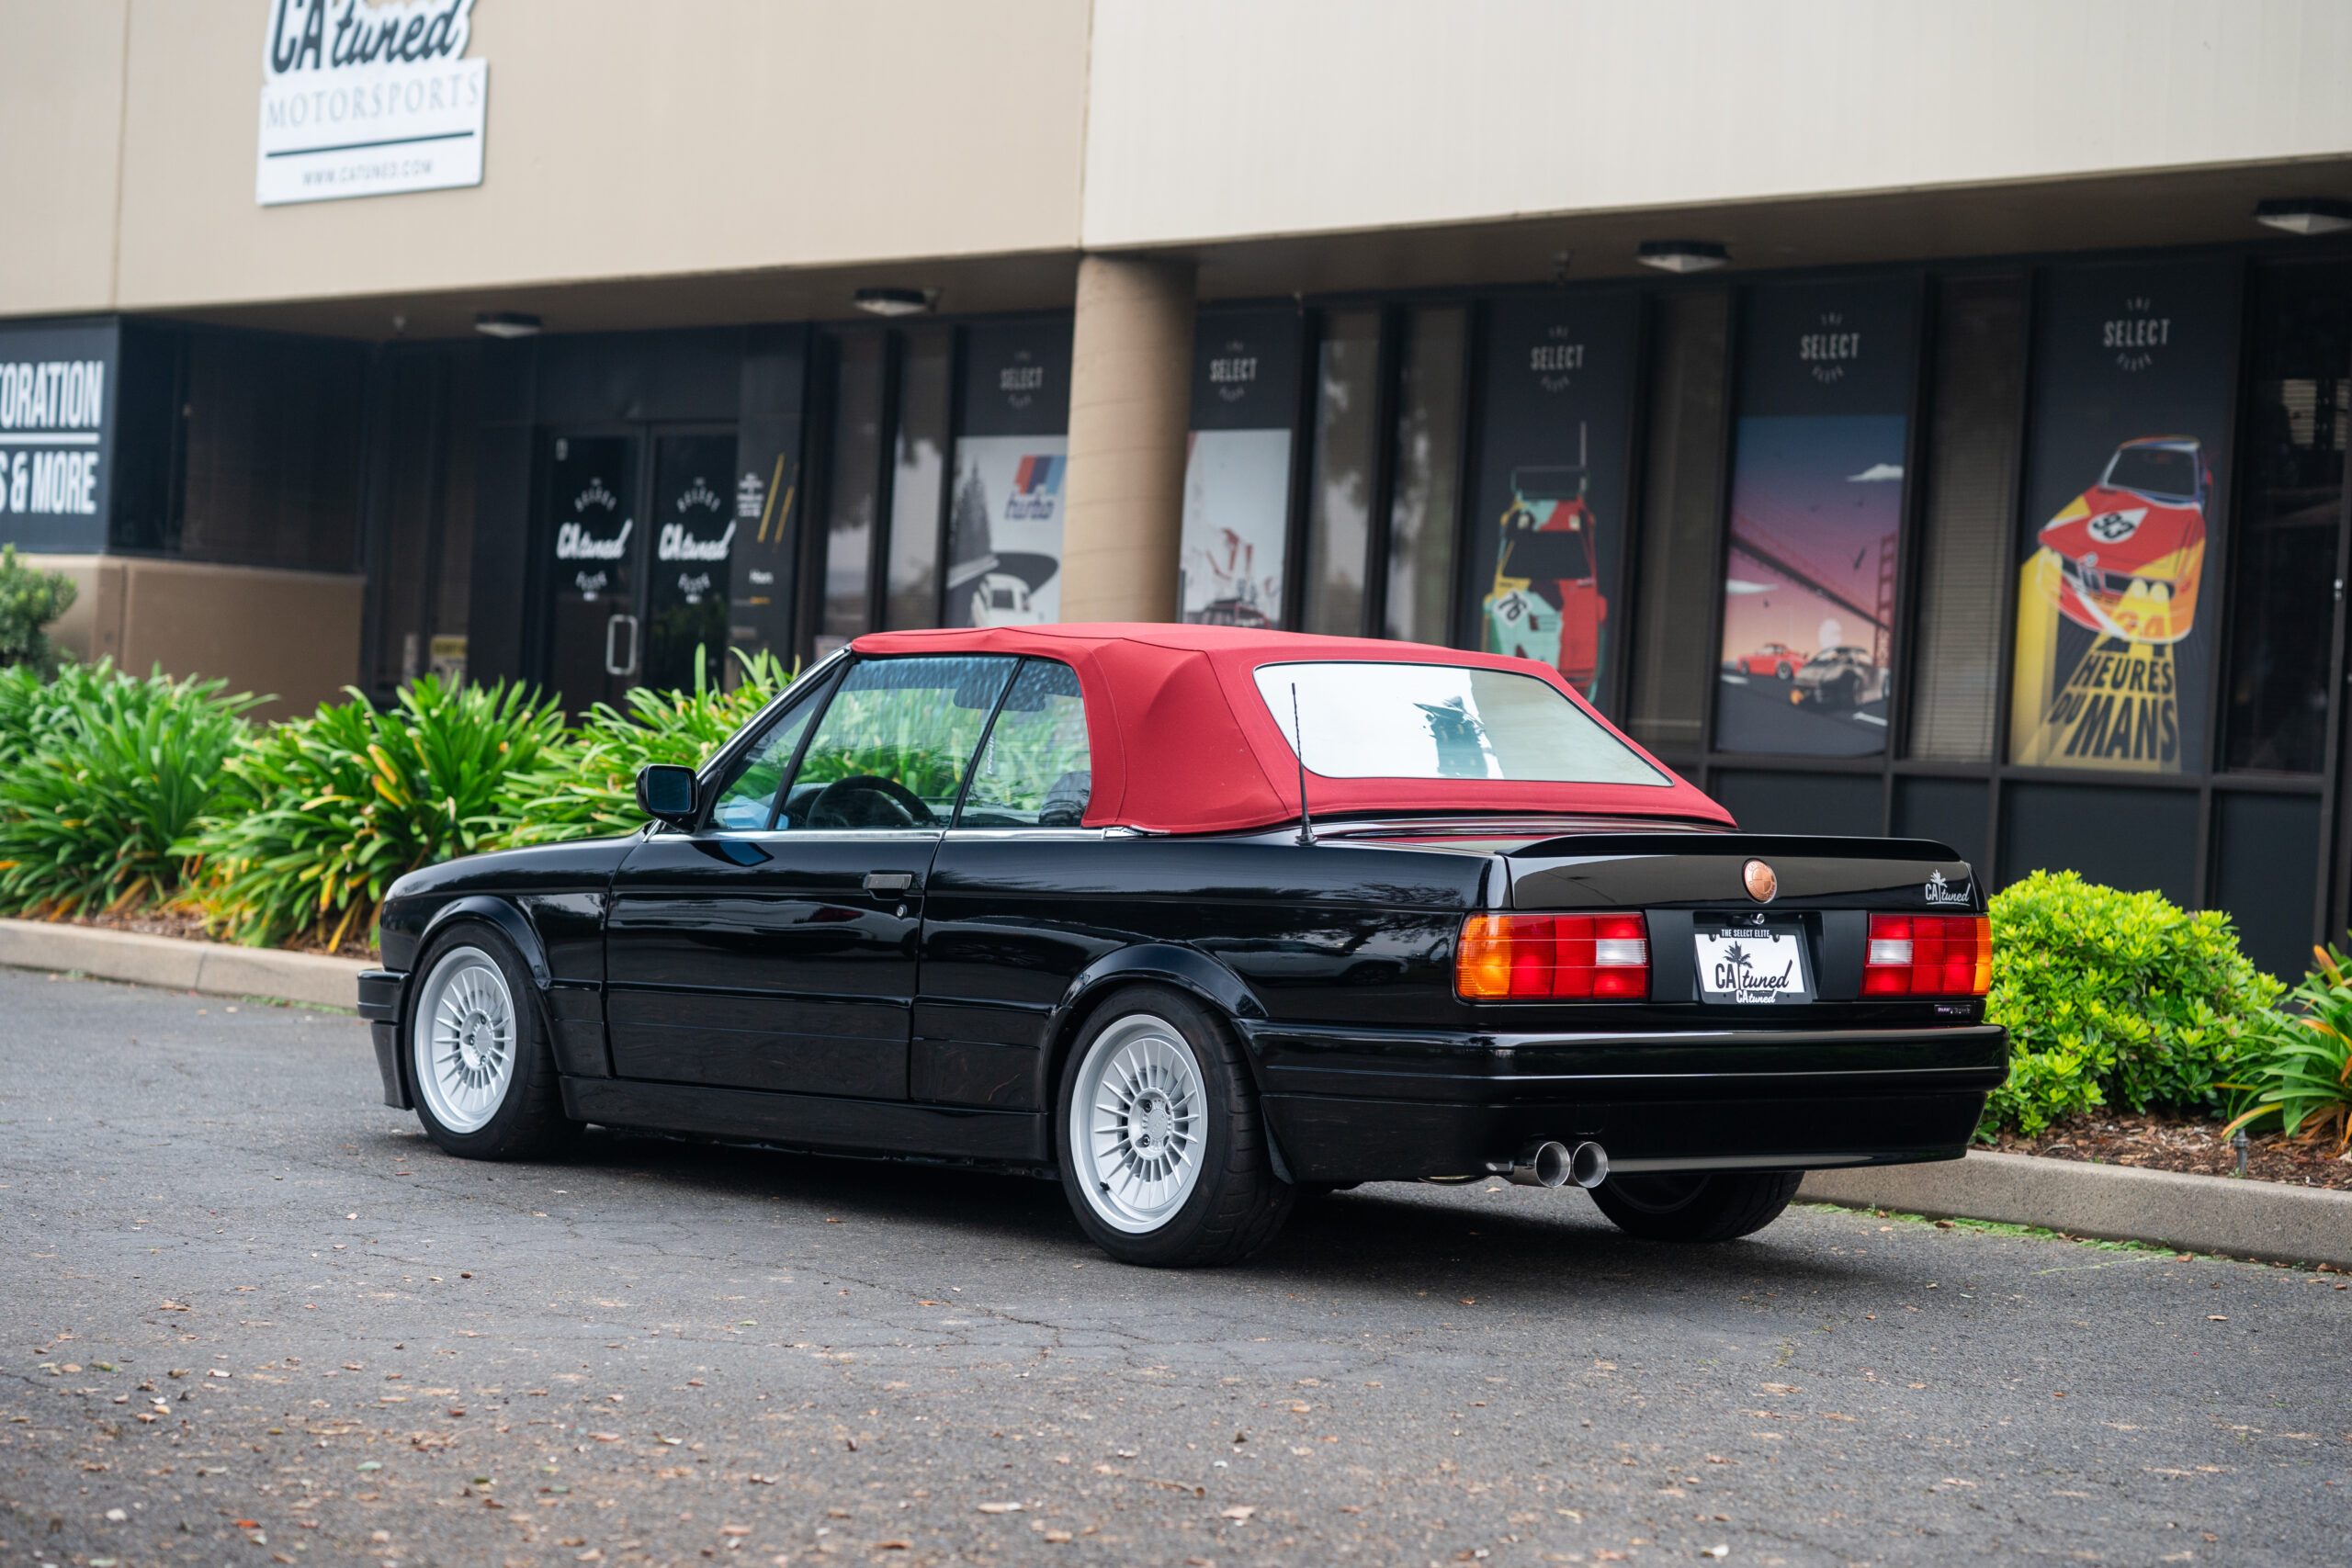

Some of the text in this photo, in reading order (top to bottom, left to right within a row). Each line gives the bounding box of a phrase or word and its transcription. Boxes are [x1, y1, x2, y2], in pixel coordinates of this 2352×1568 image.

[266, 71, 479, 130] MOTORSPORTS
[302, 159, 434, 186] WWW.CATUNED.COM
[1800, 332, 1860, 360] SELECT
[2103, 318, 2170, 347] SELECT
[1210, 357, 1258, 383] SELECT
[1531, 344, 1584, 371] SELECT
[1000, 367, 1044, 391] SELECT
[0, 360, 105, 429] ORATION
[10, 451, 28, 513] &
[30, 450, 100, 515] MORE
[2071, 654, 2173, 695] HEURES
[2048, 692, 2177, 763] DU MANS
[1721, 929, 1770, 938] THE SELECT ELITE
